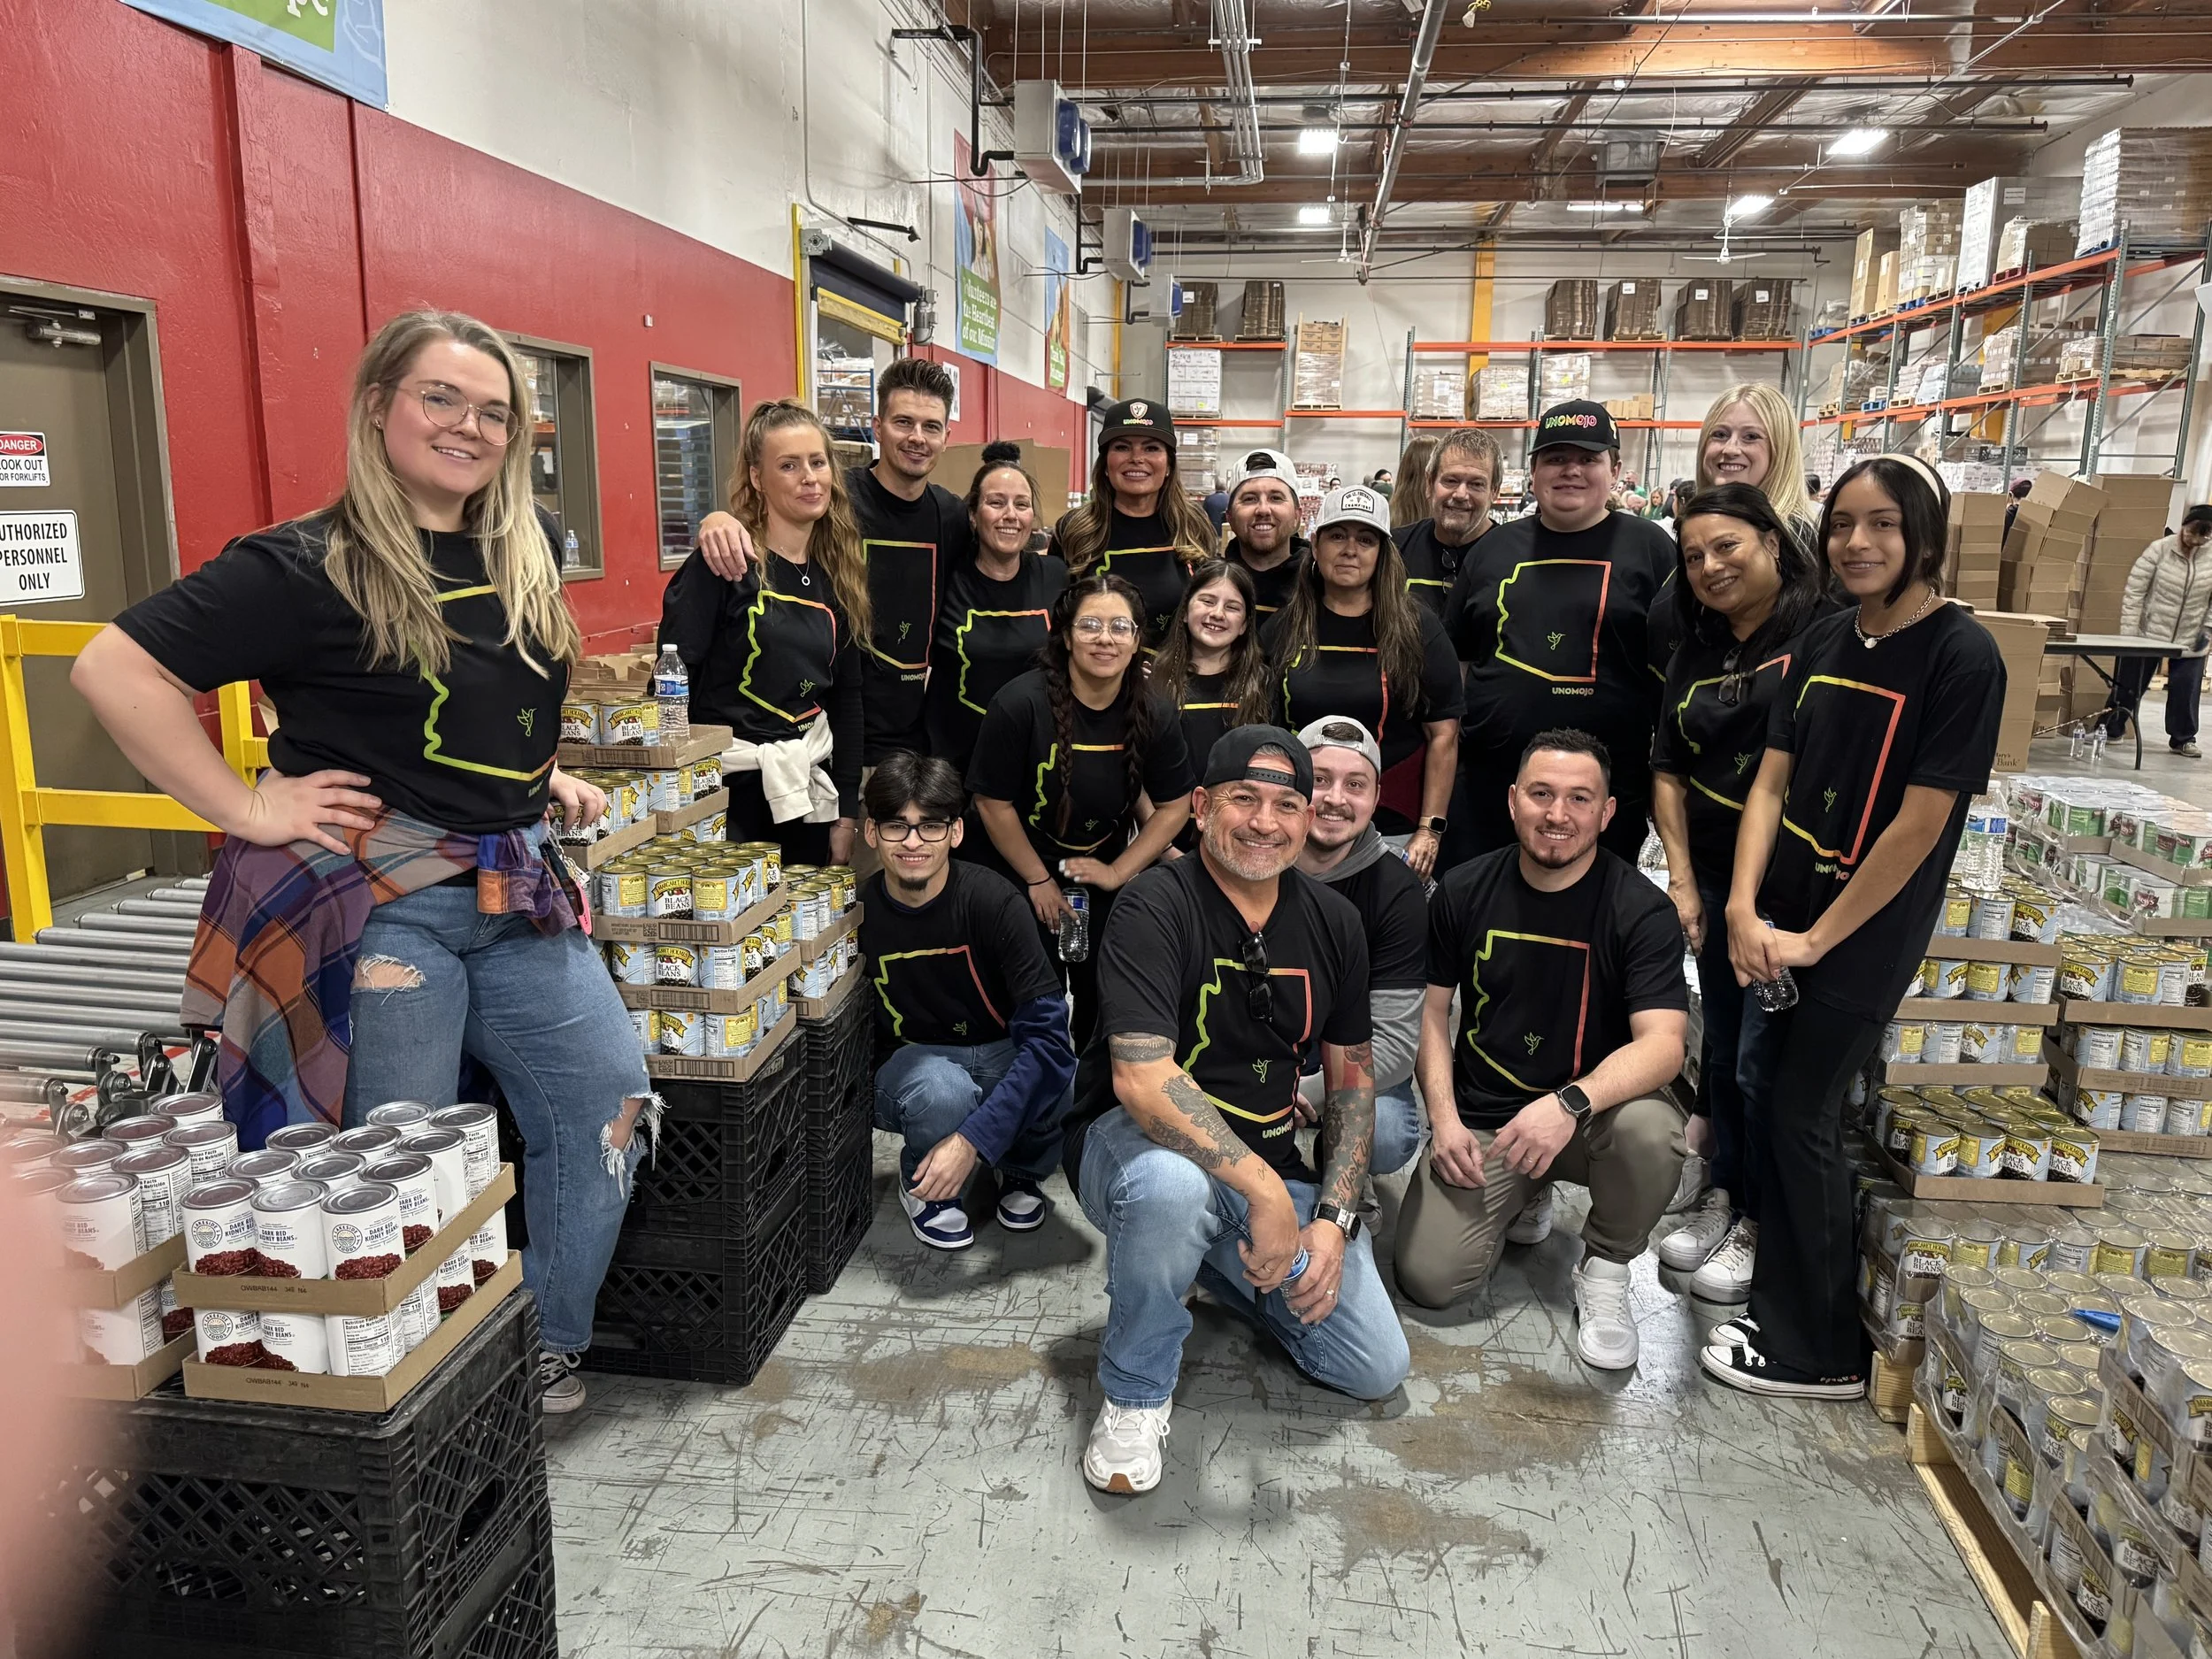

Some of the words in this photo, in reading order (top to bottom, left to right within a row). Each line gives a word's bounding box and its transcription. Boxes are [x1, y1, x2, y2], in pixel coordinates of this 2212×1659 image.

[1545, 414, 1597, 429] UNOMOJO
[0, 458, 22, 470] OOK
[25, 459, 42, 471] OUT
[0, 523, 67, 541] UTHORIZED
[19, 572, 50, 590] ONLY
[1552, 687, 1594, 696] UNOMOJO
[614, 708, 635, 718] MARGARET
[658, 880, 680, 889] MARGARET
[414, 1198, 428, 1207] BEANS
[229, 1221, 244, 1231] DARK
[369, 1225, 383, 1235] DARK
[225, 1226, 245, 1237] KIDNEY
[365, 1232, 384, 1241] KIDNEY
[480, 1235, 495, 1244] BEANS
[444, 1257, 457, 1267] DARK
[440, 1263, 457, 1273] KIDNEY
[1913, 1263, 1941, 1272] BEANS
[235, 1318, 256, 1329] KIDNEY
[240, 1314, 254, 1323] DARK
